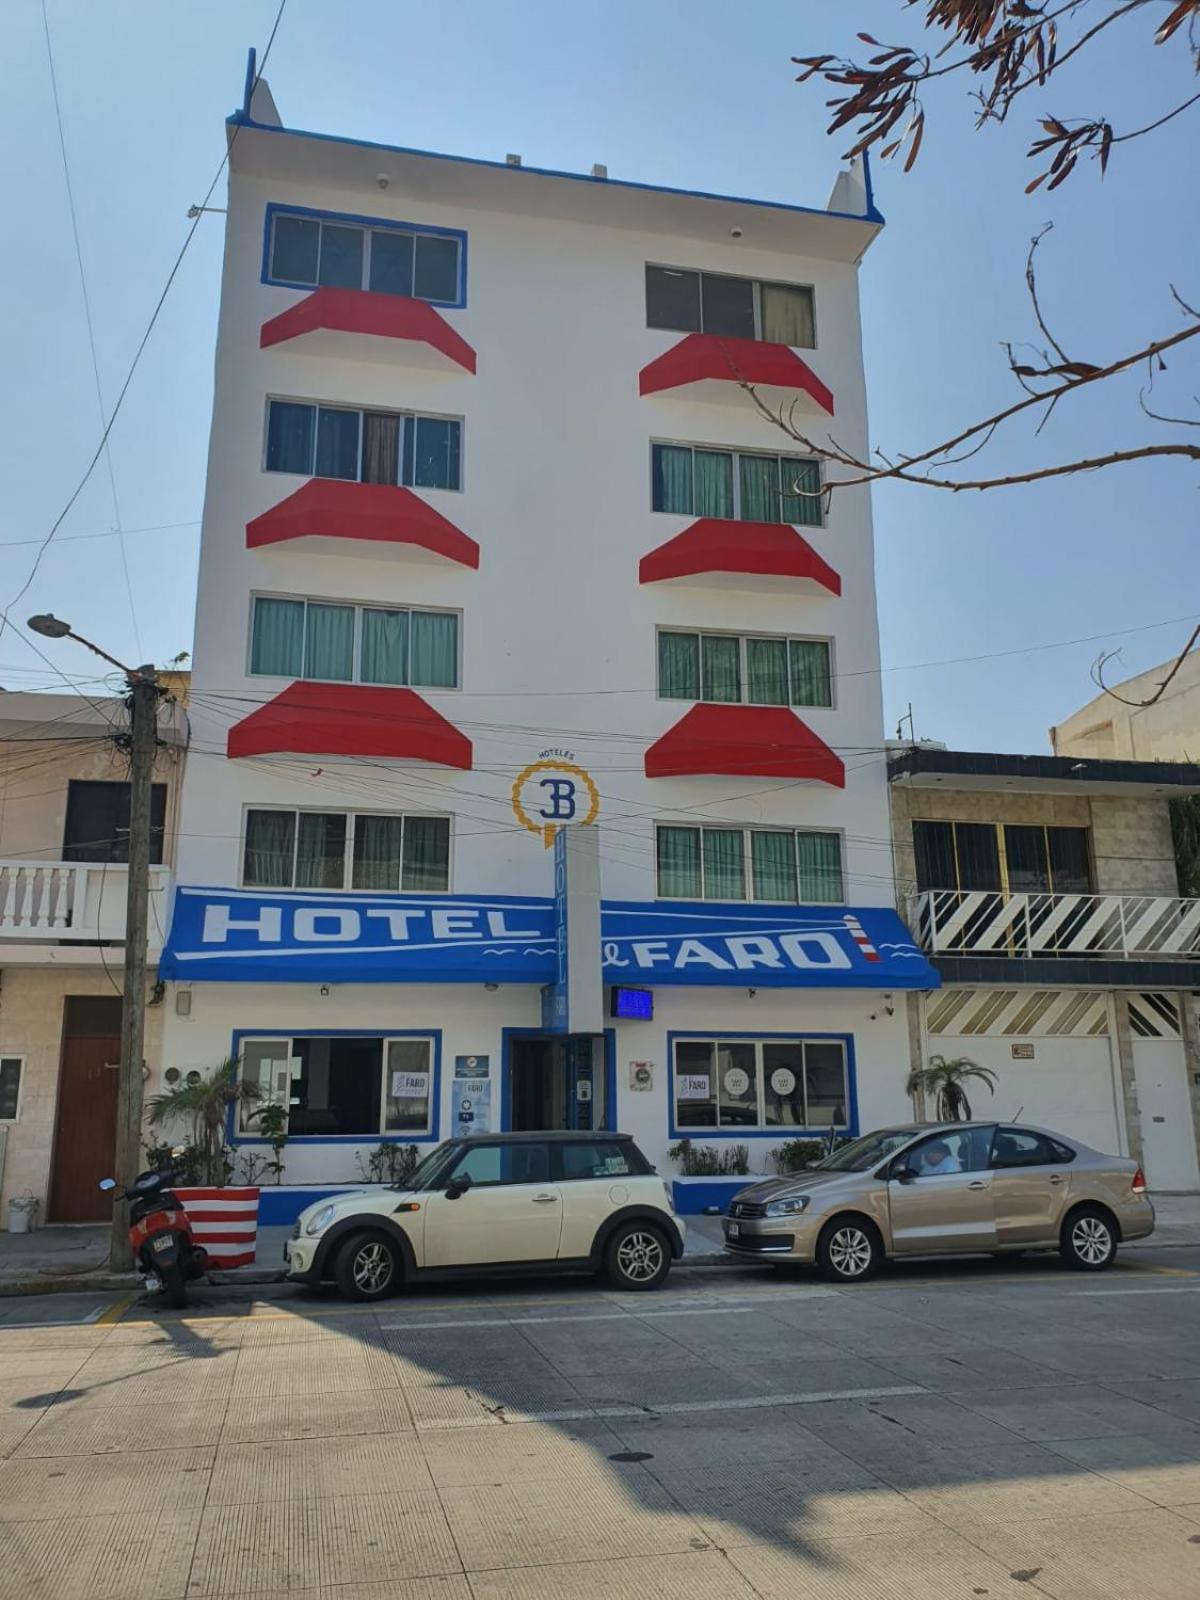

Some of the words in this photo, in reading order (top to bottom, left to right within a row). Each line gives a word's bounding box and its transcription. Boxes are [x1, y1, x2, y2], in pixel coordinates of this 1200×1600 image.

[538, 749, 576, 761] HOTELES
[555, 832, 566, 985] HOTEL
[202, 904, 541, 943] HOTEL
[632, 932, 853, 970] FARO
[405, 1077, 426, 1089] FARO
